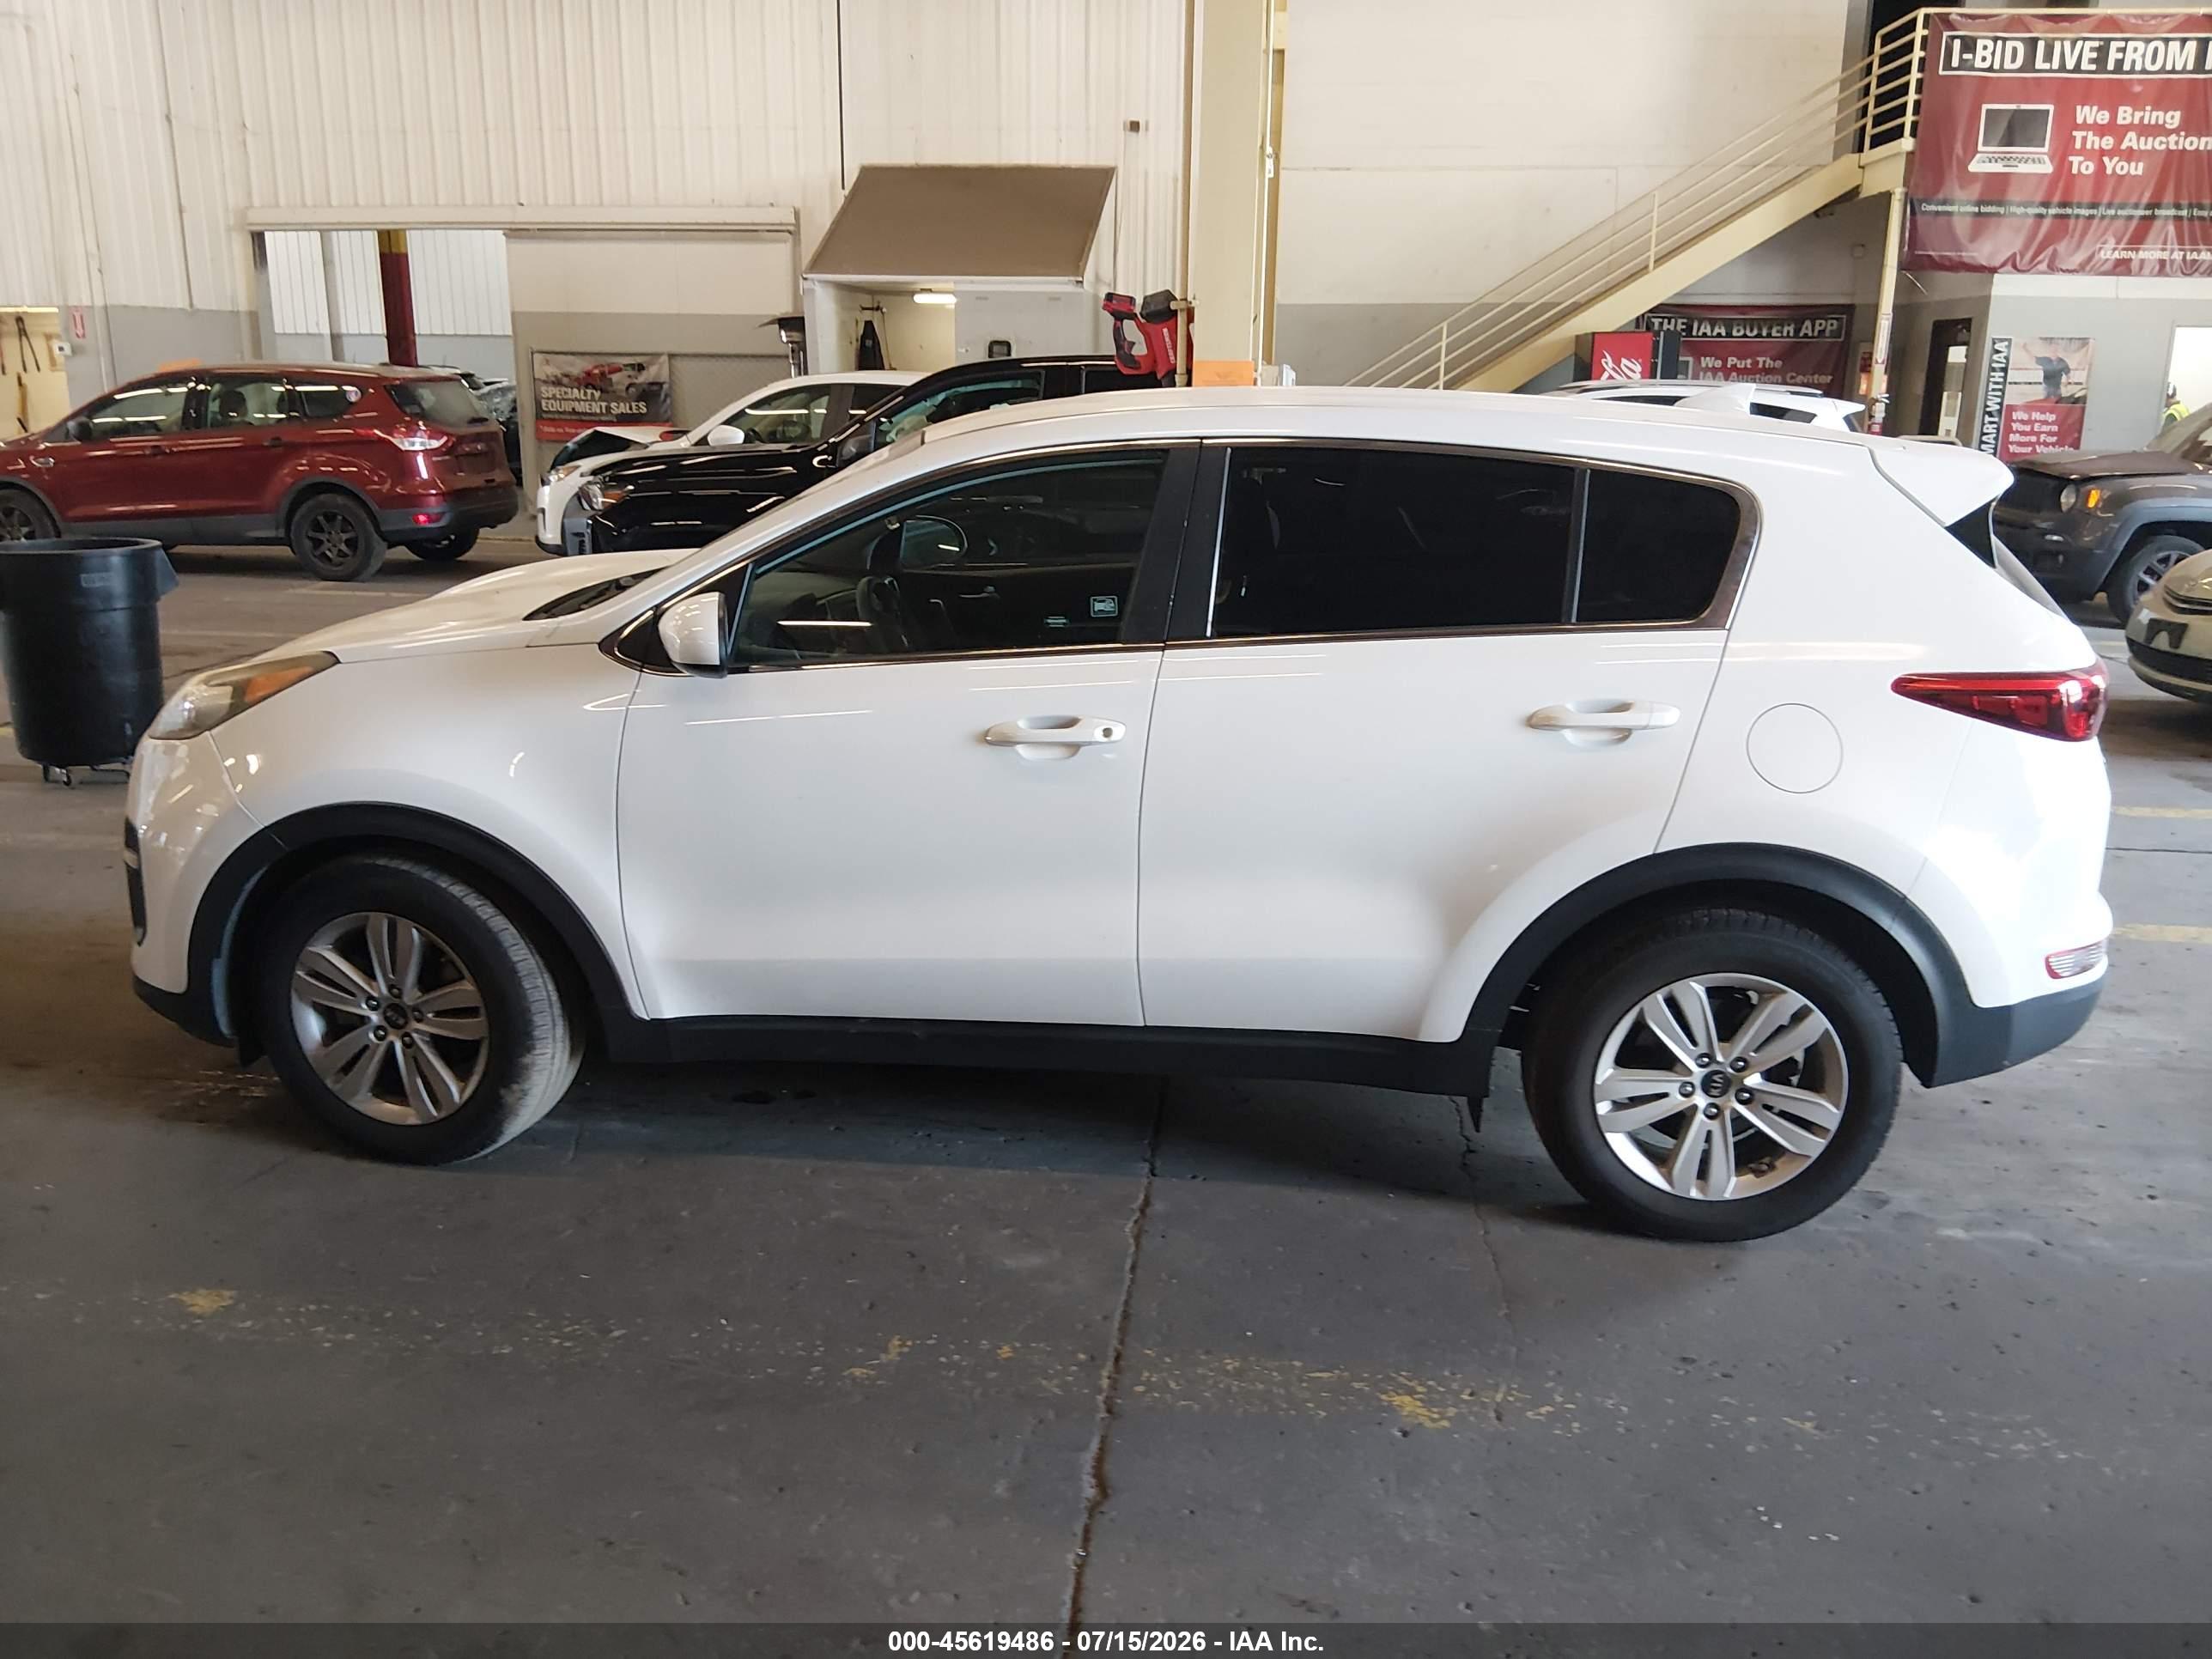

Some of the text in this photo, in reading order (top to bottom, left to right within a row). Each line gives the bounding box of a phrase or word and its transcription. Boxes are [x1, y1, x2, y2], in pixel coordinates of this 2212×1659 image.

[1951, 39, 2025, 70] I-BID
[2034, 40, 2098, 70] LIVE
[2106, 40, 2197, 71] FROM
[2075, 105, 2181, 129] We Bring
[2072, 131, 2212, 150] The Auction
[2069, 155, 2144, 175] To You
[2101, 250, 2136, 259] LEARN
[2137, 251, 2169, 259] MORE
[2170, 251, 2185, 260] AT
[1650, 318, 1838, 337] THE IAA BUYER APP
[1700, 356, 1783, 368] We Put The
[1991, 341, 2009, 368] IAA
[1699, 371, 1833, 384] IAA Auction Center
[540, 386, 601, 401] SPECIALTY
[1985, 372, 2005, 412] WITH
[541, 398, 647, 414] EQUIPMENT SALES
[2012, 411, 2056, 422] We Help
[2011, 422, 2058, 432] You Earn
[2008, 433, 2058, 443] More For
[2008, 444, 2033, 453] Your
